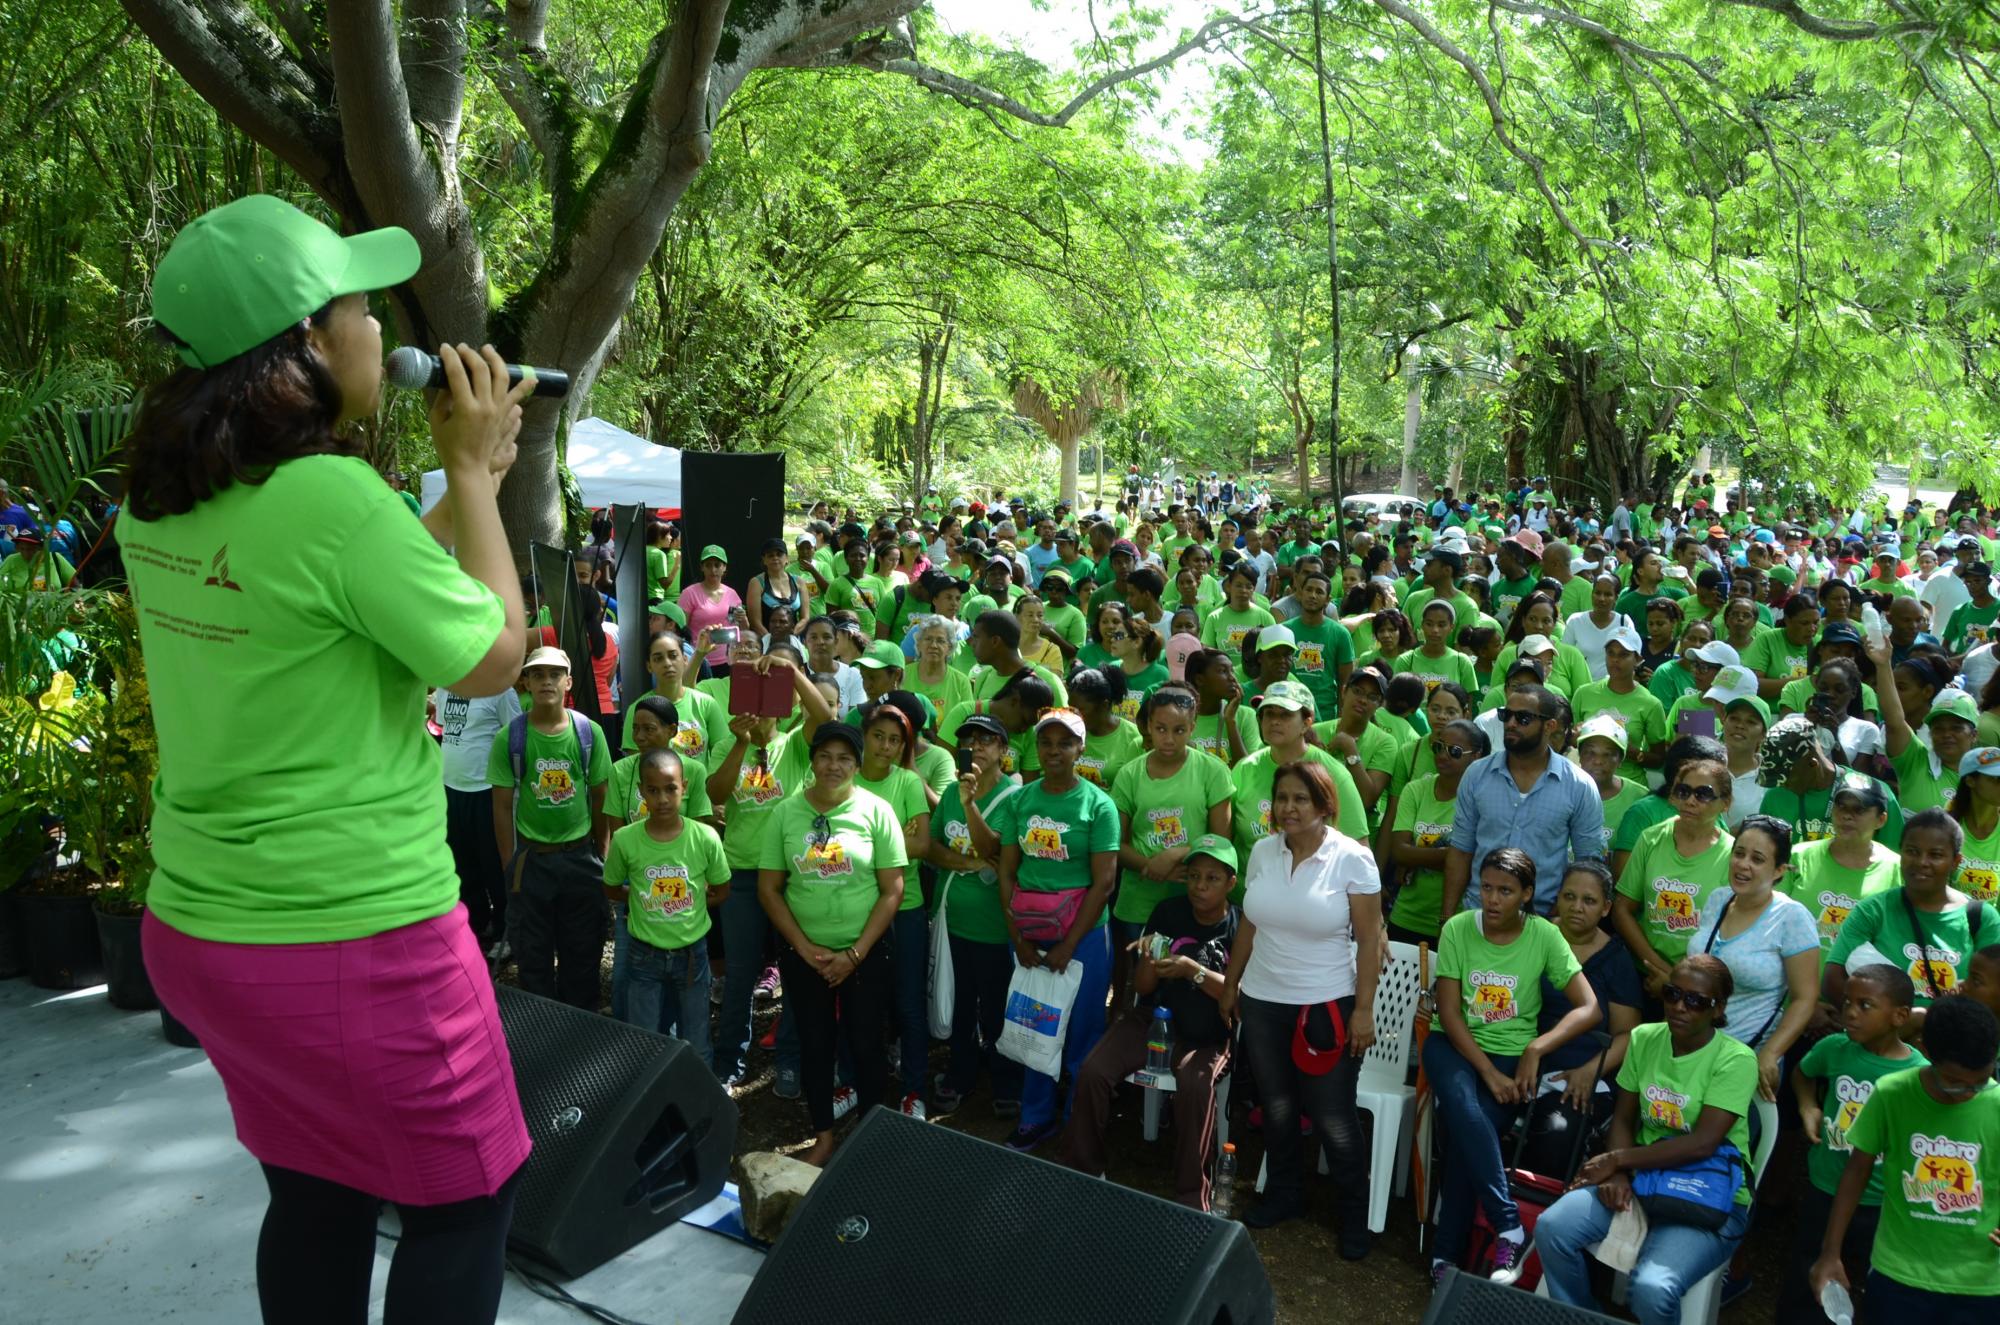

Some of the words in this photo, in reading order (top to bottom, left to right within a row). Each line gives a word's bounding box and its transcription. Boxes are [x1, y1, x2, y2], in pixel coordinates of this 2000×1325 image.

[446, 702, 468, 716] UNO
[1652, 876, 1699, 896] Quiero
[1469, 970, 1517, 990] Quiero
[1910, 1132, 1979, 1164] Quiero
[1934, 1181, 1983, 1214] Sano!
